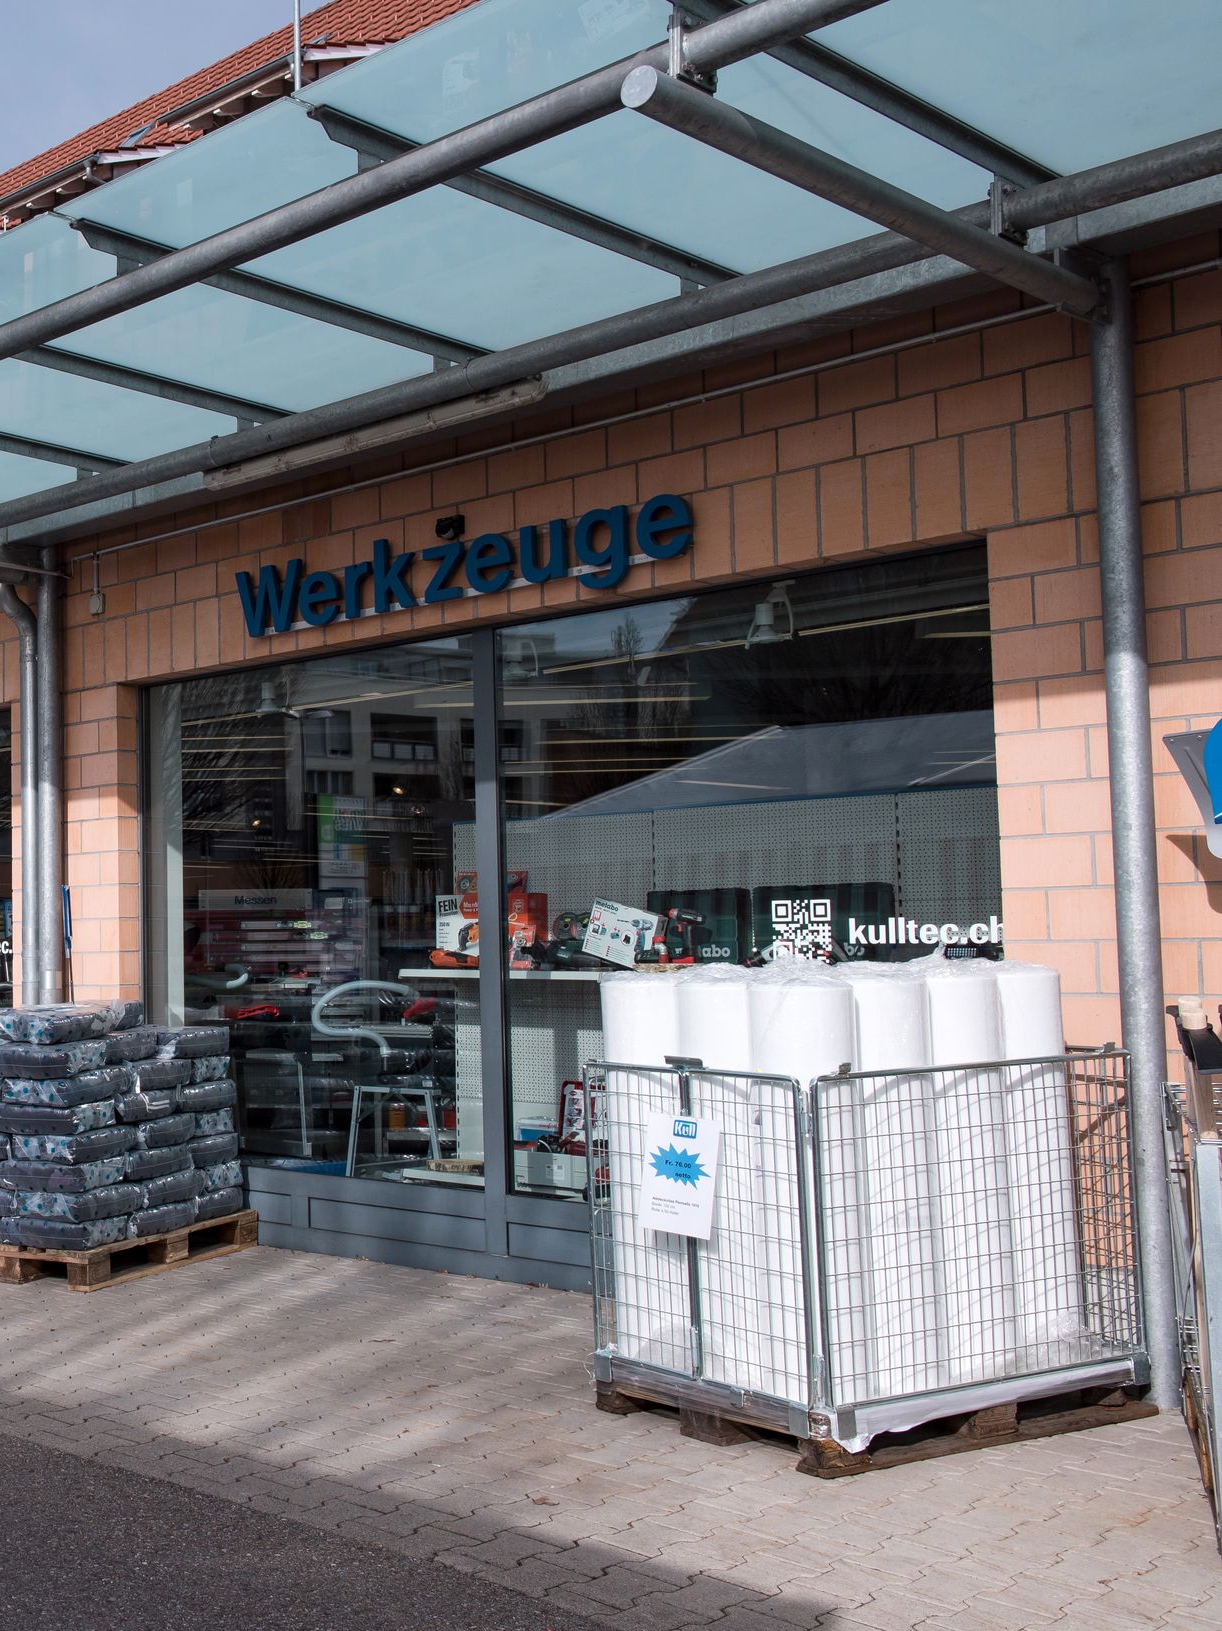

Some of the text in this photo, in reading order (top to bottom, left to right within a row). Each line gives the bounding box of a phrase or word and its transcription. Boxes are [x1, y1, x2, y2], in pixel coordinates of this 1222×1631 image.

[235, 493, 694, 638] Werkzeuge
[234, 895, 277, 905] Messen
[438, 898, 458, 913] FEIN
[595, 900, 619, 912] metabo
[674, 1121, 696, 1137] Kull
[675, 1161, 692, 1169] 76.00
[675, 1172, 691, 1180] netto
